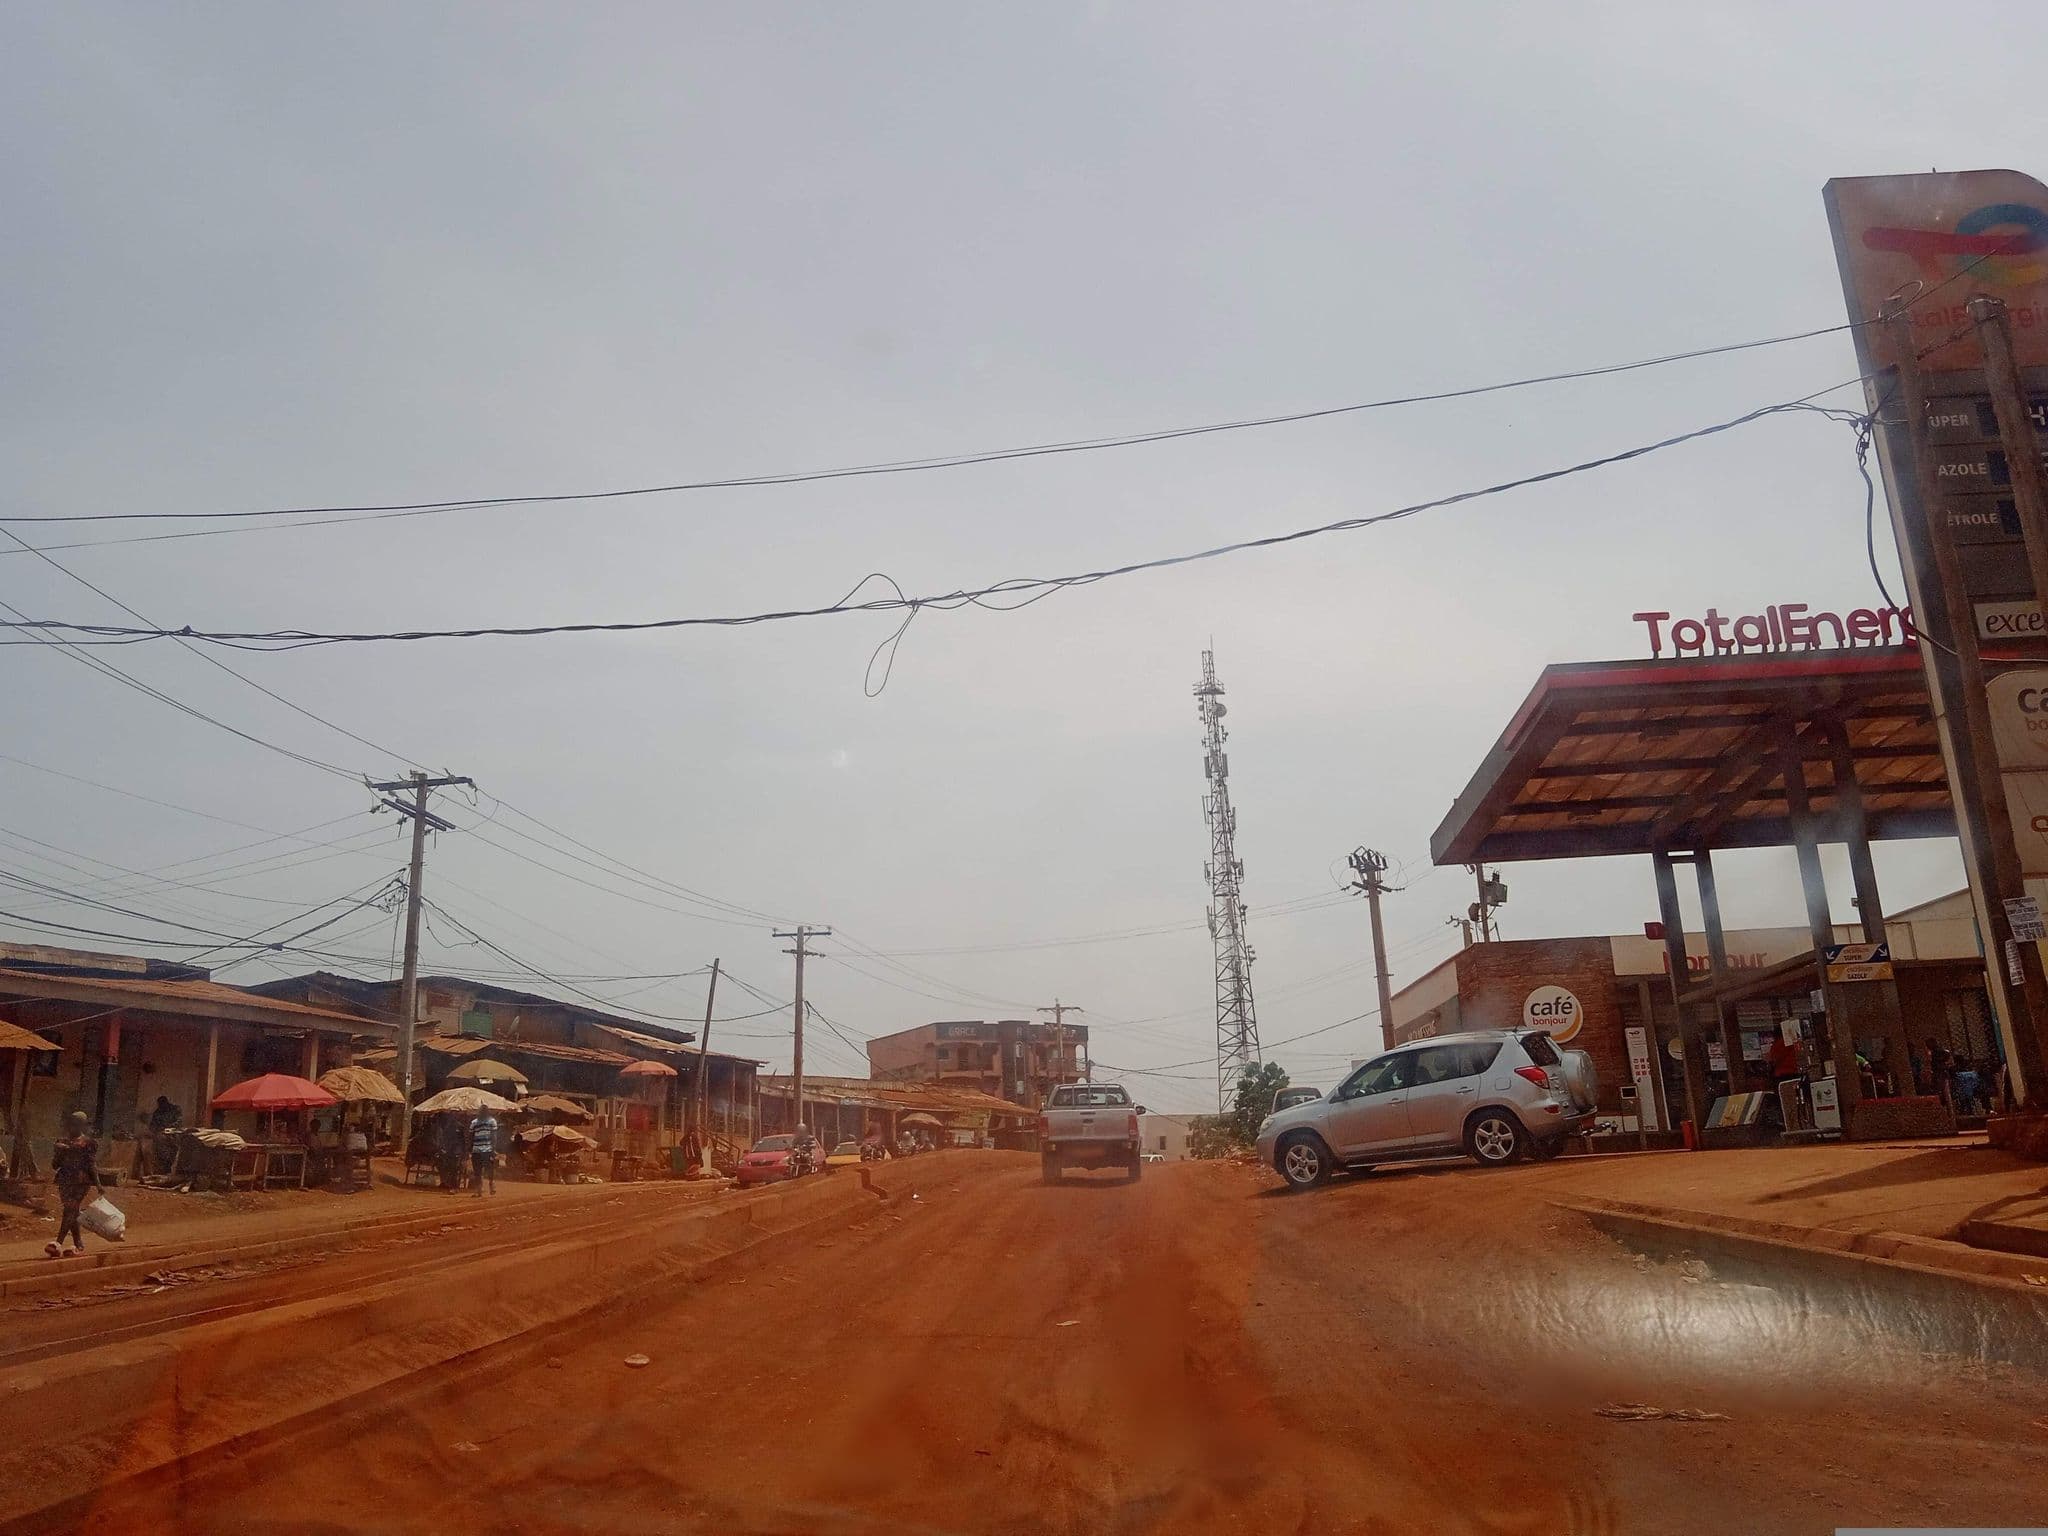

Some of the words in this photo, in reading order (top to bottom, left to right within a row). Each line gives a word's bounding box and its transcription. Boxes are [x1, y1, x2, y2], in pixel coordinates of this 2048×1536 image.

[1938, 463, 1987, 476] AZOLE
[1947, 512, 1999, 526] ETROLE
[1985, 612, 2046, 634] exce
[1530, 996, 1573, 1016] café
[1532, 1016, 1568, 1027] bonjour
